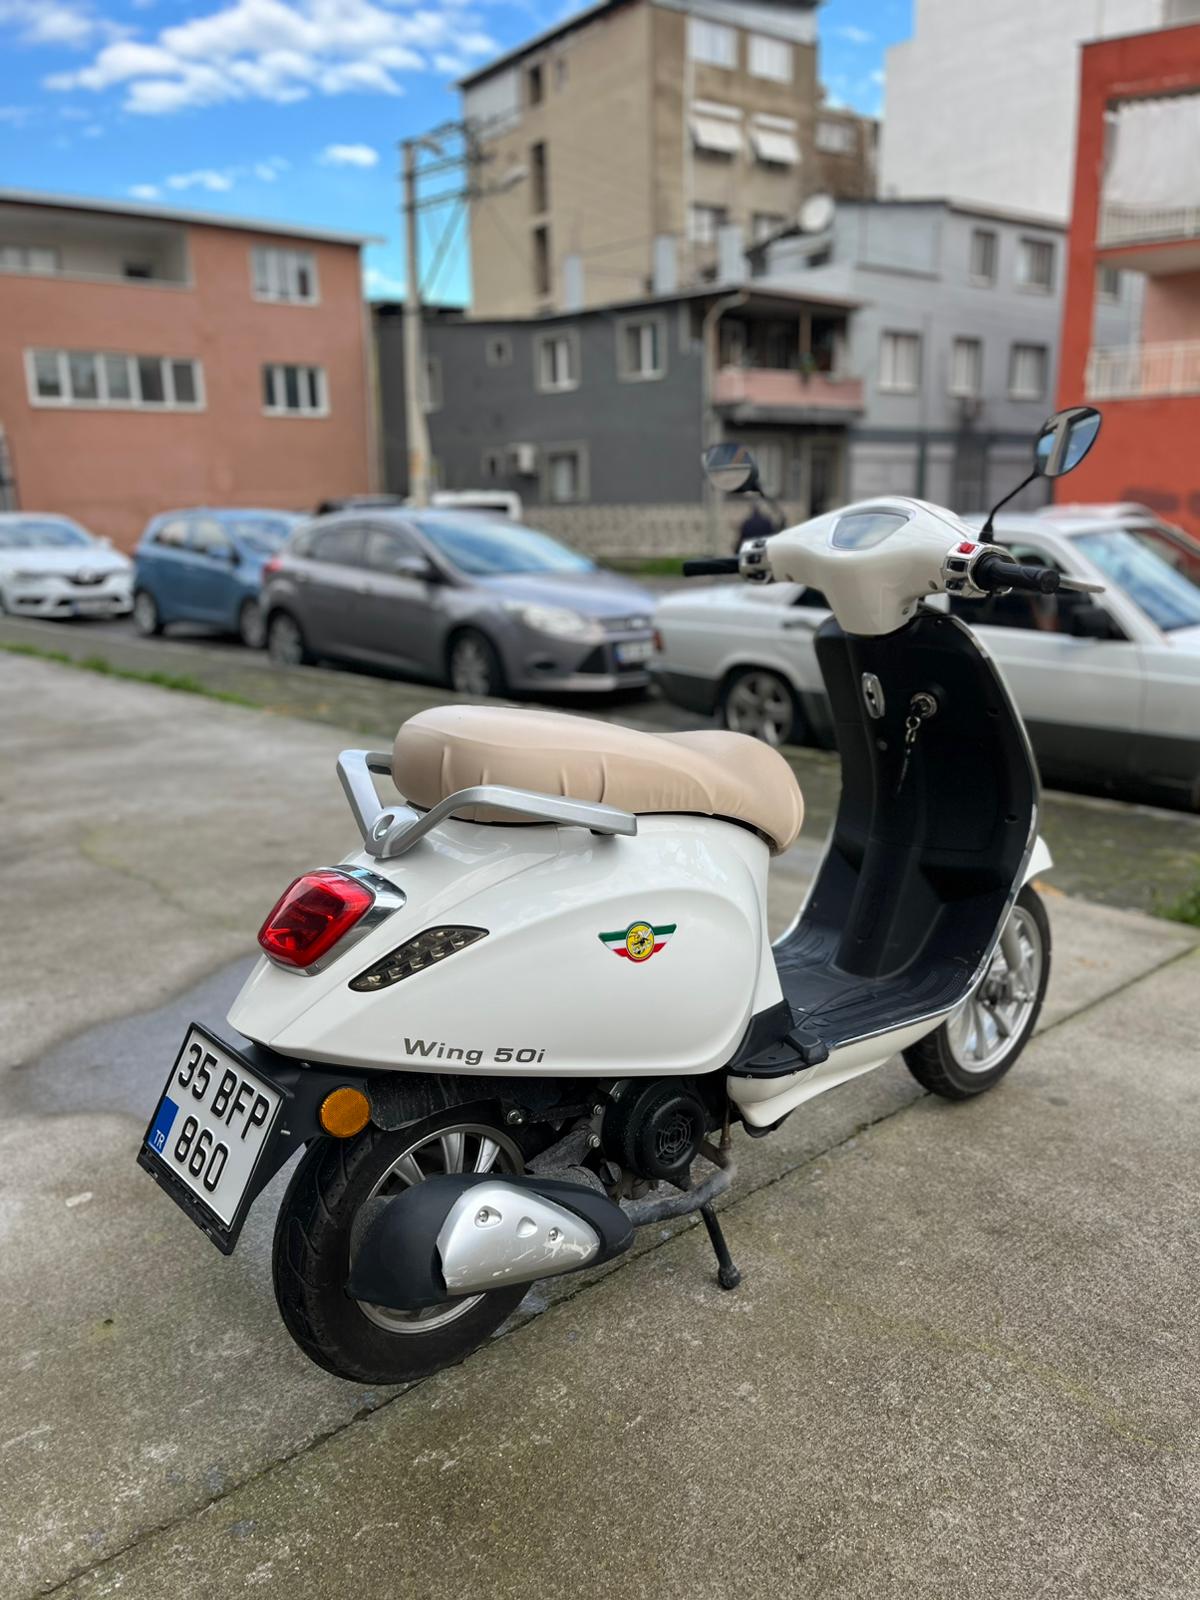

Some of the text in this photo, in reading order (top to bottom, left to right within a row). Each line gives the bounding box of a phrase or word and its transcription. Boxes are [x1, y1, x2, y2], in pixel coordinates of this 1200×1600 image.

[404, 1038, 546, 1066] Wing 50i
[178, 1043, 270, 1140] 35 BFP
[153, 1129, 165, 1148] TR
[174, 1115, 229, 1193] 860
